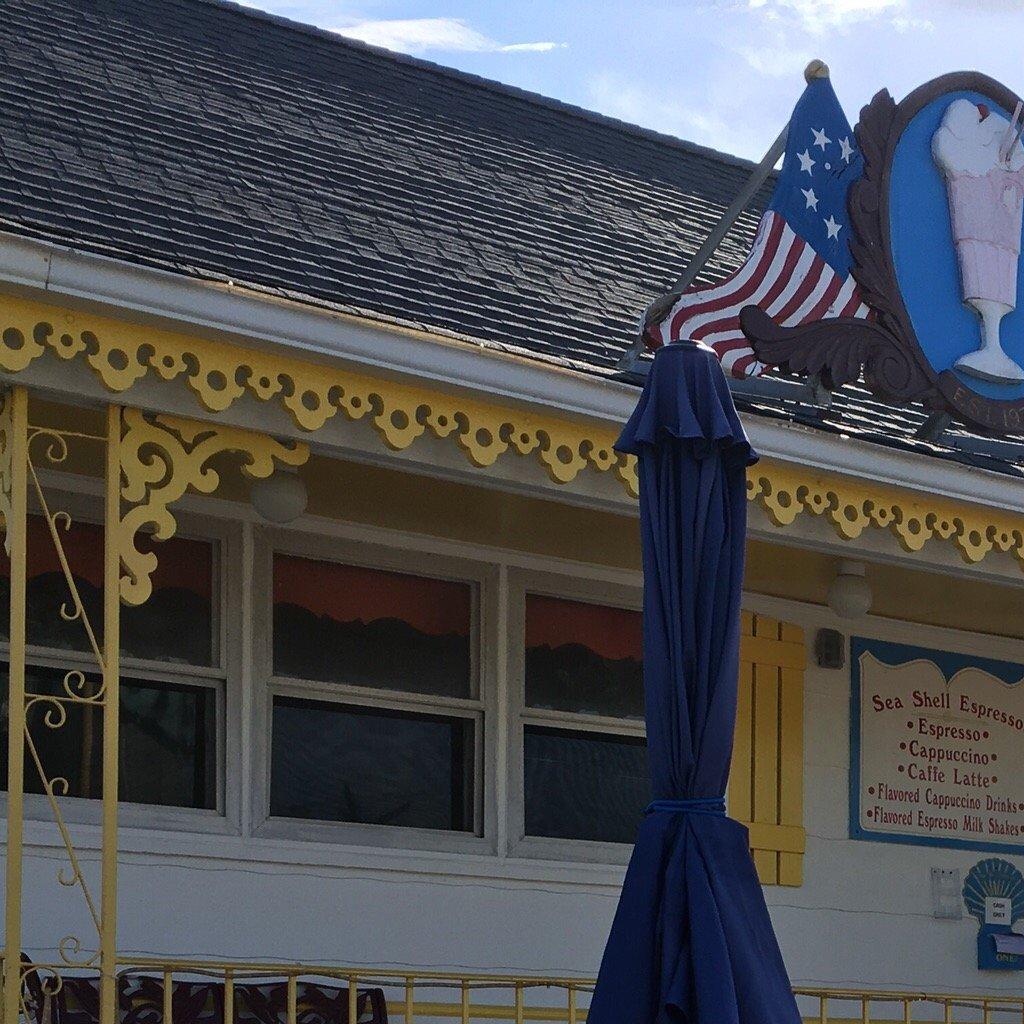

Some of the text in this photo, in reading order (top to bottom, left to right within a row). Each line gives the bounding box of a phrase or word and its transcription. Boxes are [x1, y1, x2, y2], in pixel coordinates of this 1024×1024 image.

[872, 690, 1024, 730] Sea Shell Espresso
[918, 718, 981, 741] Espresso
[909, 740, 989, 766] Cappuccino
[907, 763, 990, 788] Caffe Latte
[878, 783, 1018, 814] Flavored Cappuccino Drinks
[874, 805, 1019, 837] Flavored Espresso Milk Shakes
